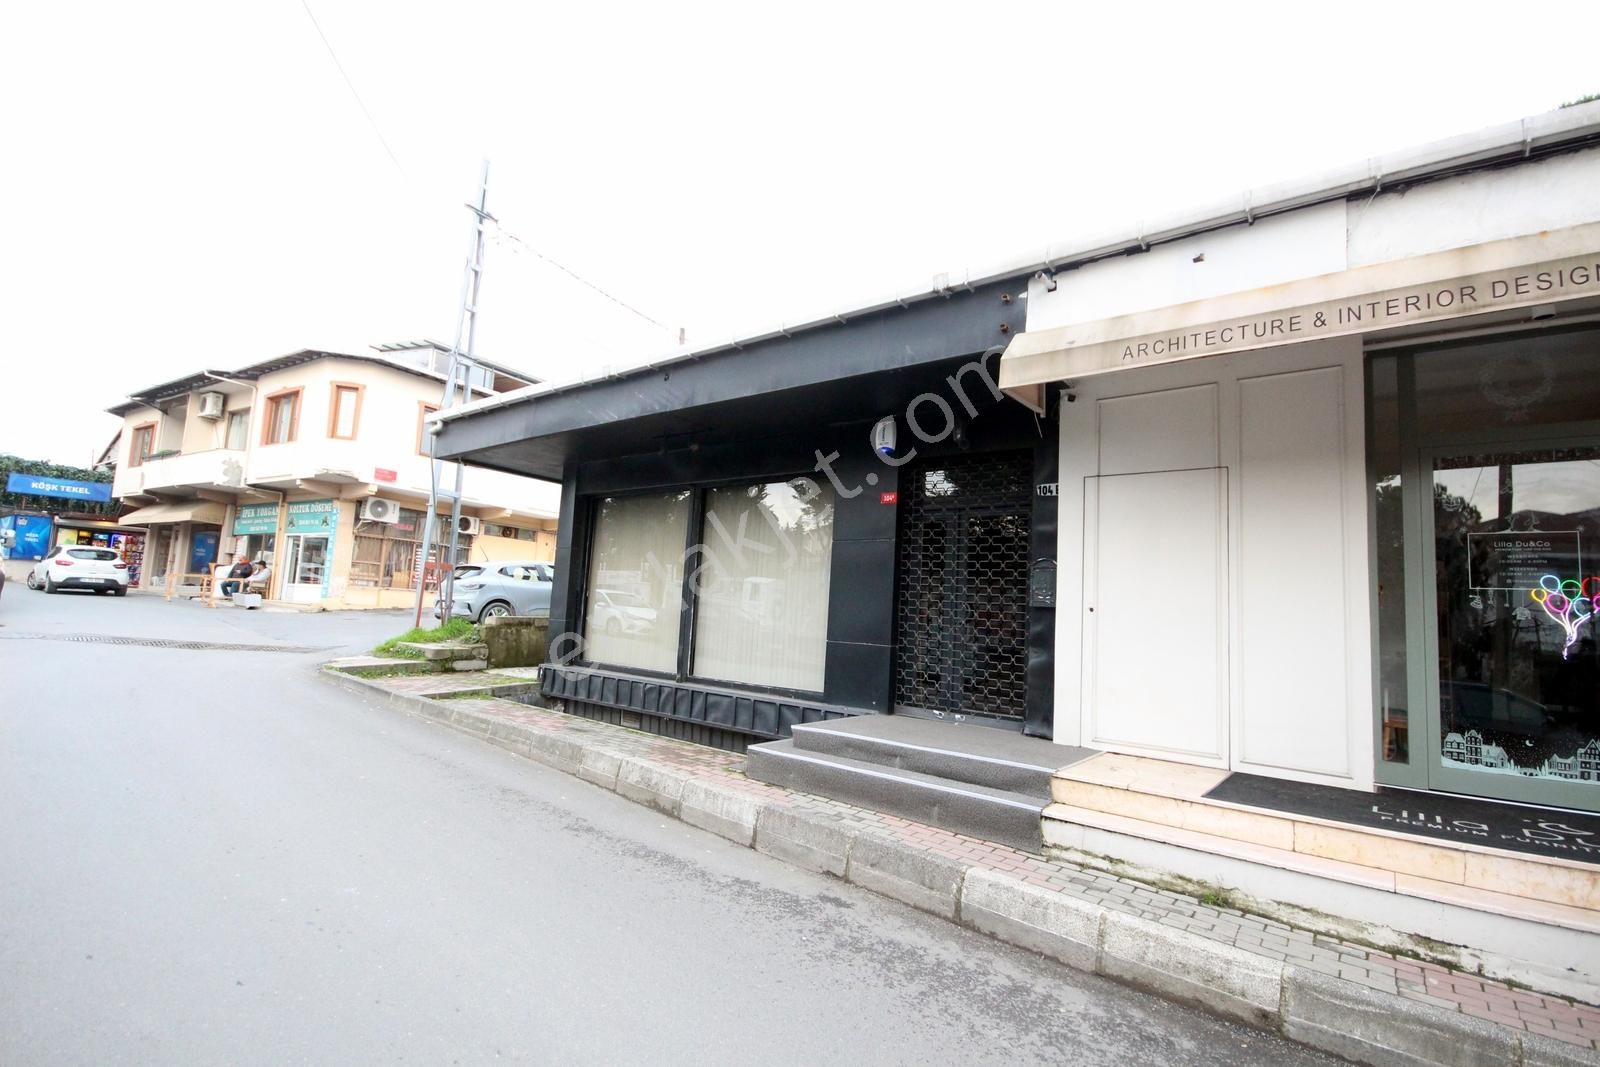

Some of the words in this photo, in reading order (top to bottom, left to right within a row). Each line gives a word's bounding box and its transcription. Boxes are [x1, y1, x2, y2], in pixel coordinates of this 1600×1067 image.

[1122, 315, 1302, 360] ARCHITECTURE
[1313, 311, 1328, 328] &
[1338, 285, 1477, 325] INTERIOR
[60, 485, 91, 494] TEKEL
[1037, 485, 1053, 496] 104
[1515, 540, 1551, 548] Du&Co
[1381, 816, 1488, 837] PREMIUM
[1501, 834, 1600, 854] FURNIT
